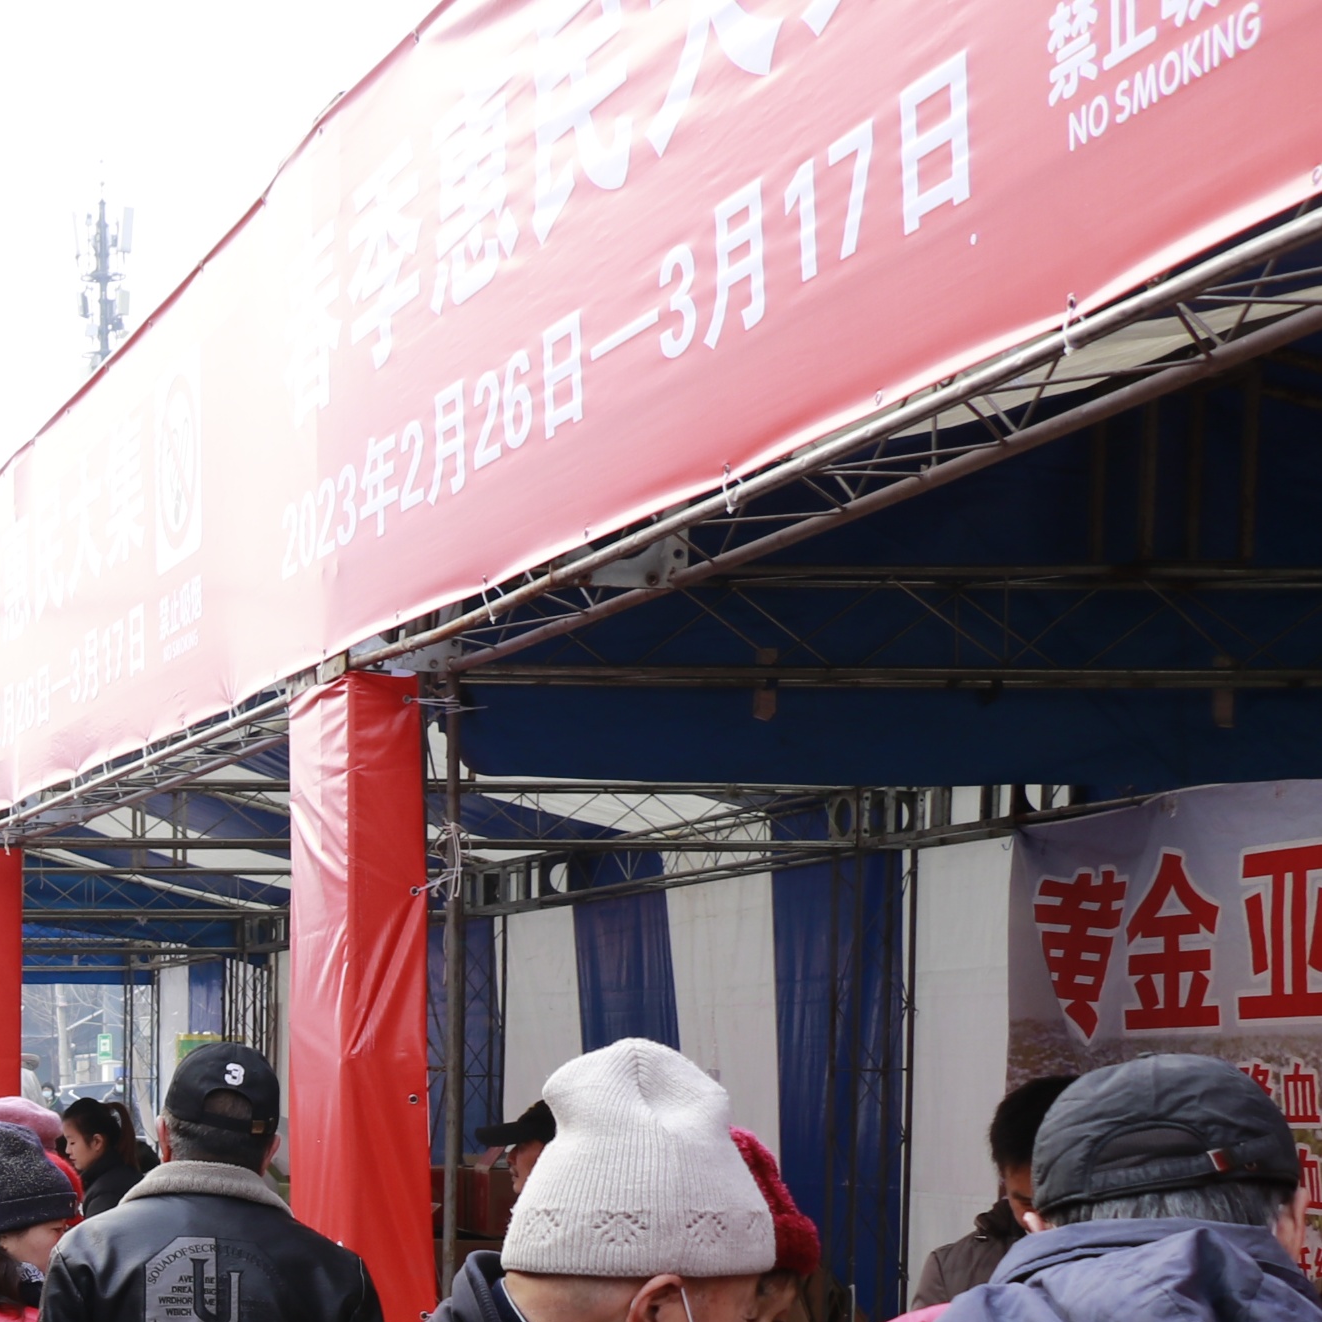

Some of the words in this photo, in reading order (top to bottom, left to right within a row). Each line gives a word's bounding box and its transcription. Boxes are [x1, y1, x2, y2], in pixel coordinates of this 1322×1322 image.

[1048, 0, 1221, 107] 禁止
[1069, 95, 1109, 152] NO
[1115, 2, 1261, 123] SMOKING
[282, 0, 845, 432] 春季惠民大
[1034, 840, 1322, 1044] 黄金亚
[224, 1062, 247, 1087] 3
